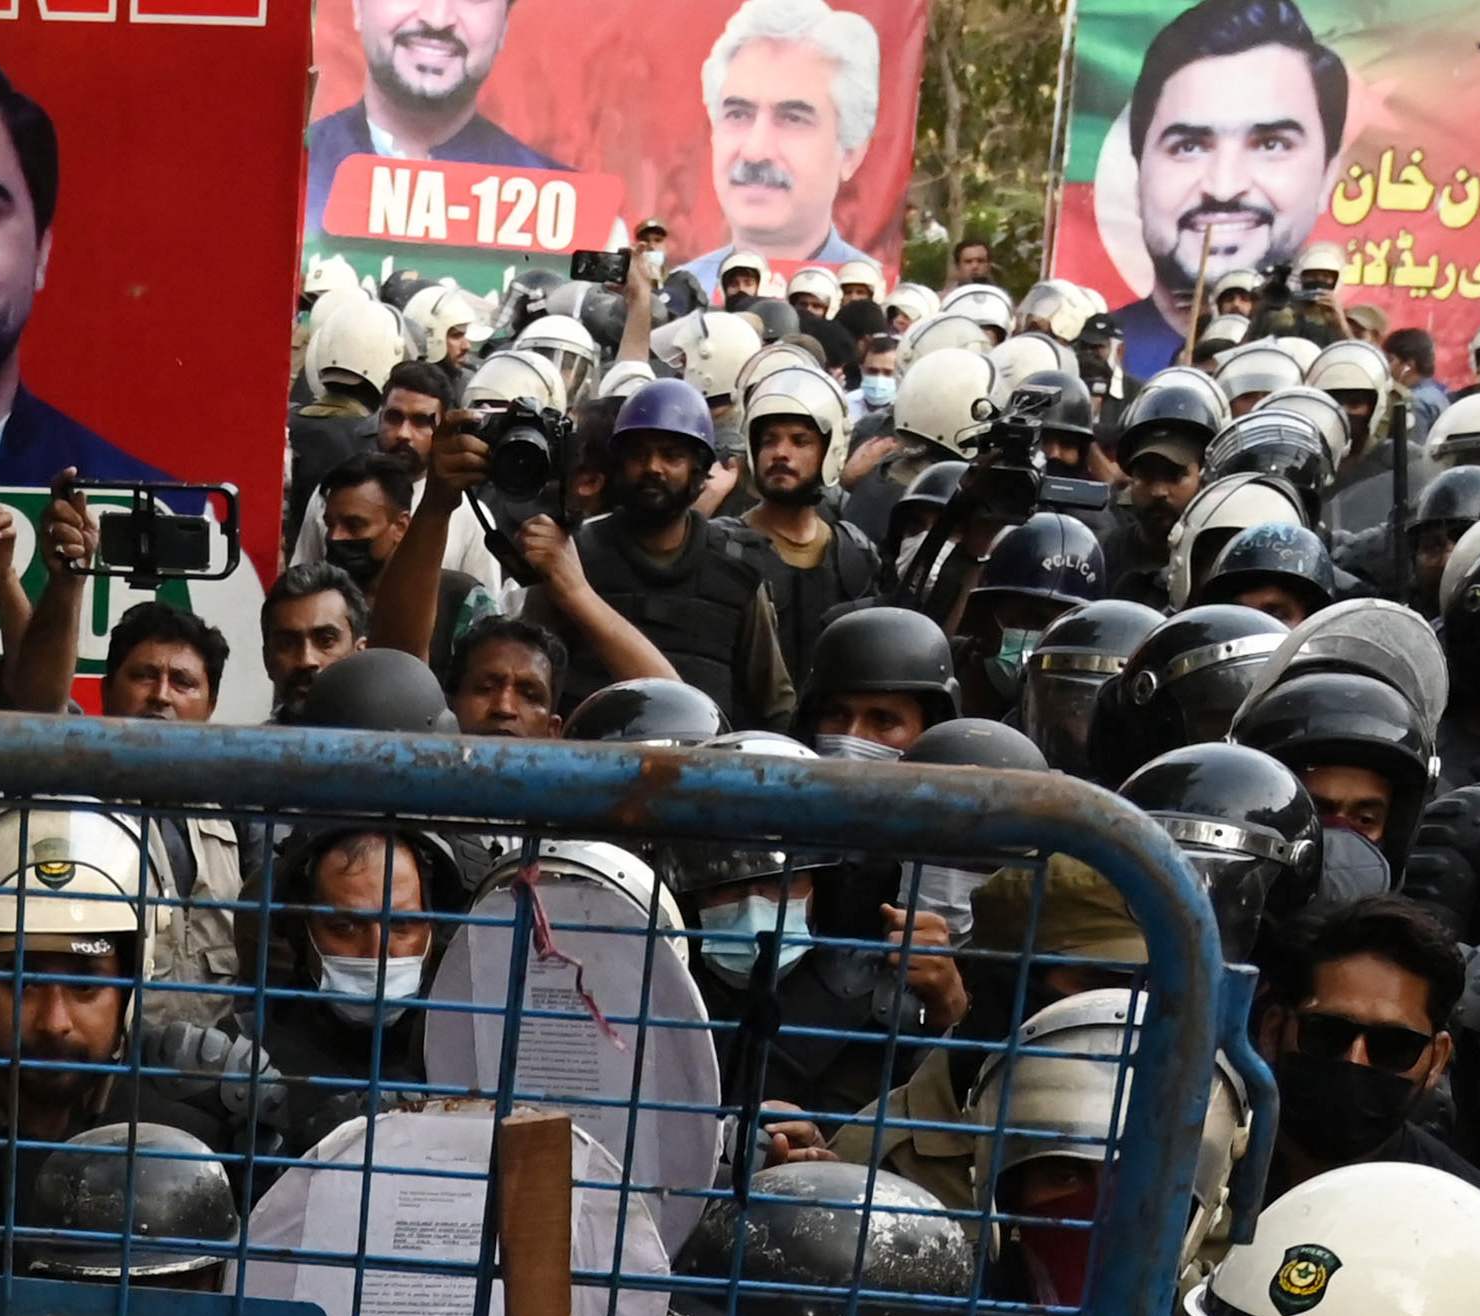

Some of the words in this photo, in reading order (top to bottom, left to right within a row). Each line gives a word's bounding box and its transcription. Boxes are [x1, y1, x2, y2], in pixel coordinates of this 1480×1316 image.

[367, 165, 577, 251] NA-120
[1330, 145, 1436, 226] خان
[1041, 553, 1098, 585] POLICE
